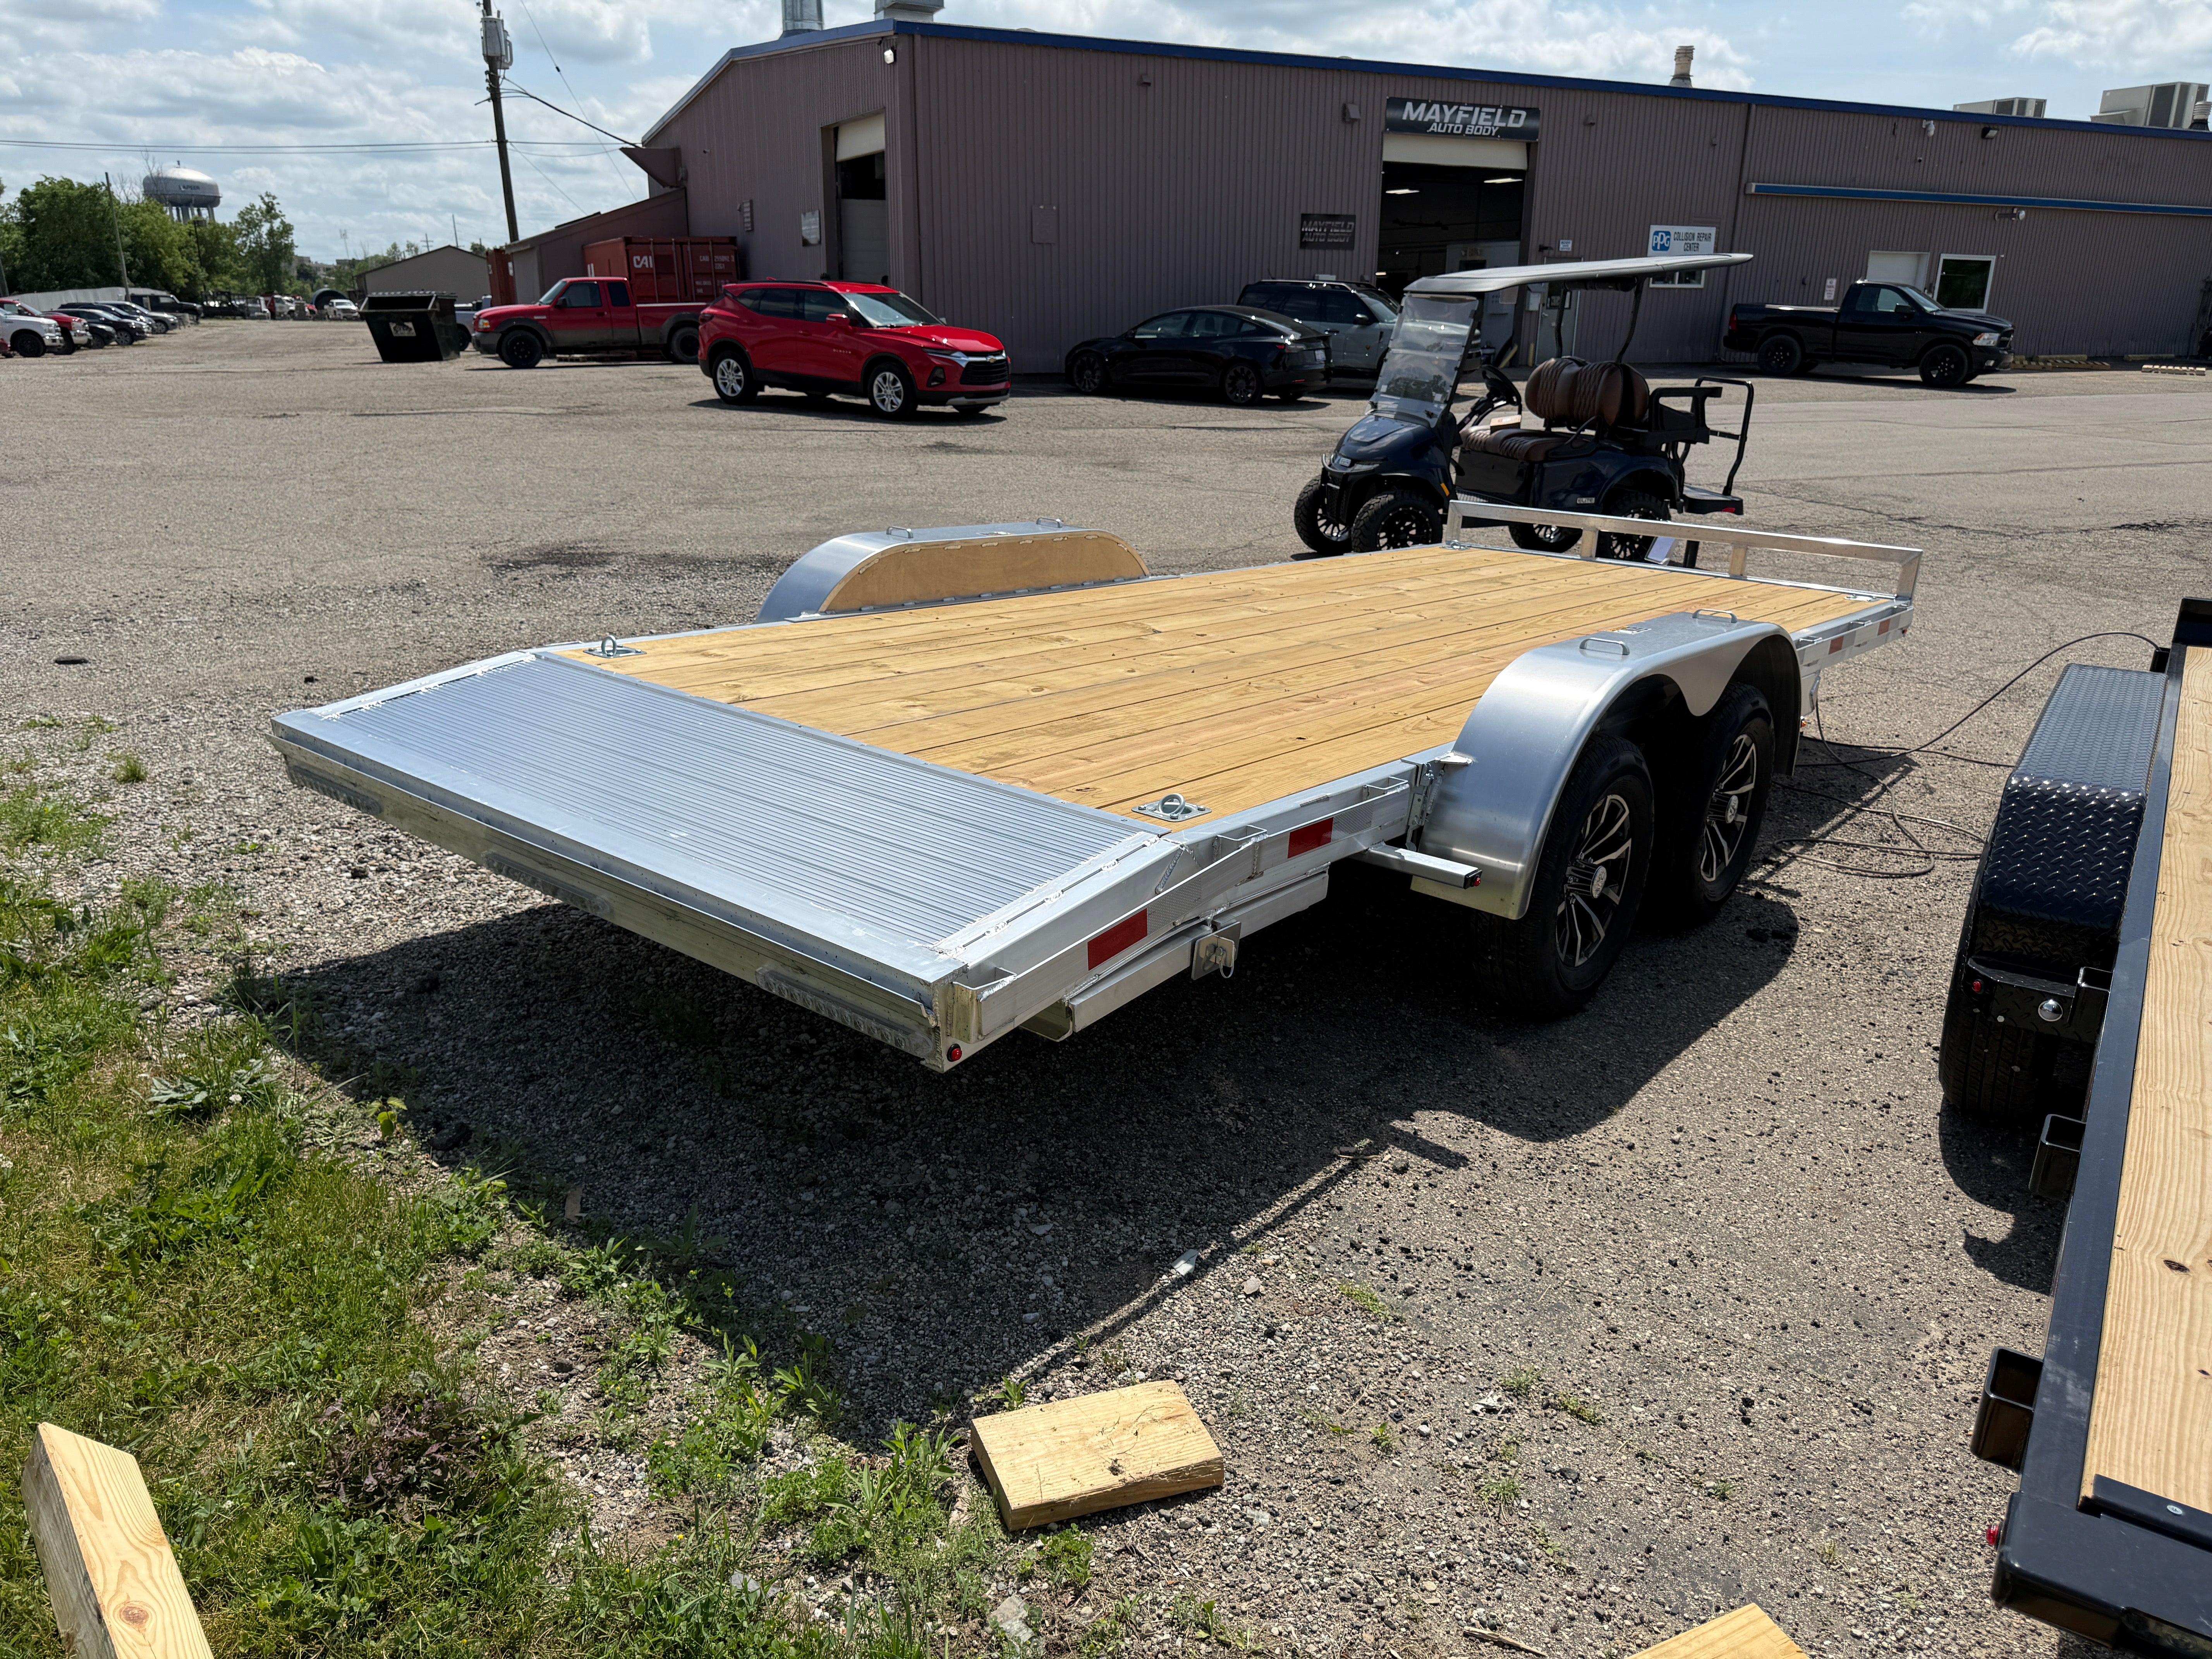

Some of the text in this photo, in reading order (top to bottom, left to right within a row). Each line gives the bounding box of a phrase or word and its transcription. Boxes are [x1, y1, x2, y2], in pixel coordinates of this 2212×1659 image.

[1402, 101, 1527, 128] MAYFIELD
[1429, 123, 1499, 136] AUTO BODY
[1301, 221, 1355, 232] MAYFIELD
[1302, 233, 1352, 242] AUTO BODY
[1652, 232, 1670, 250] PPG
[1673, 232, 1712, 242] COLLISION REPAIR
[1683, 242, 1700, 252] CENTER
[633, 256, 653, 268] CAI
